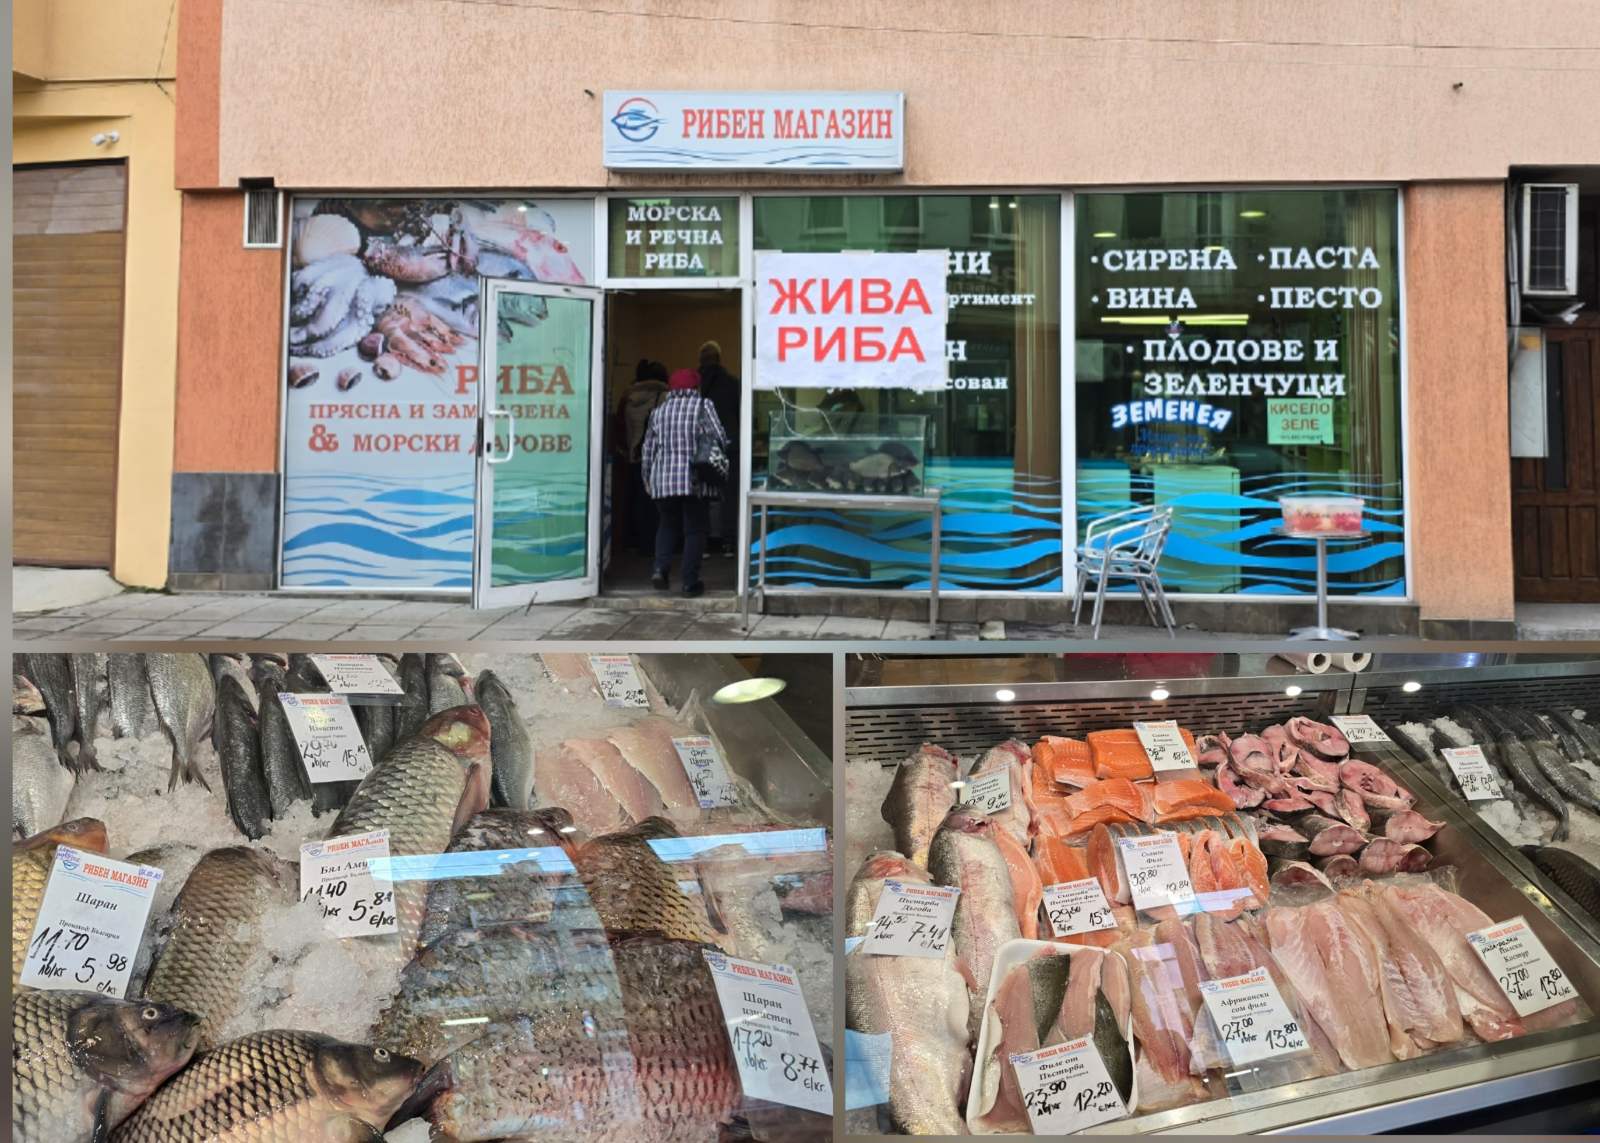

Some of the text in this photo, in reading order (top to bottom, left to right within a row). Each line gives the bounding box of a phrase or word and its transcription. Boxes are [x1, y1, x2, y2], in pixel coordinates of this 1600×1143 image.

[682, 109, 893, 139] РИБЕН МАГАЗИН
[627, 206, 722, 222] МОРСКА
[625, 230, 723, 245] И РЕЧНА
[645, 254, 704, 270] РИБА
[1102, 247, 1380, 271] СИРЕНА ПАСТА
[769, 278, 933, 315] ЖИВА
[949, 291, 1036, 306] ртимент
[1106, 287, 1383, 309] ВИНА ПЕСТО
[777, 326, 926, 363] РИБА
[1143, 339, 1338, 365] ПЛОДОВЕ И
[1144, 373, 1346, 399] ЗЕЛЕНЧУЦИ
[308, 404, 571, 419] ПРЯСНА И ЗАМАЗЕНА
[1111, 398, 1232, 431] ЗЕМЕНЕЯ
[1270, 402, 1330, 416] КИСЕЛО
[1281, 418, 1320, 430] ЗЕЛЕ
[308, 424, 340, 452] &
[353, 434, 461, 452] МОРСКИ
[83, 863, 109, 879] РИБЕН
[110, 870, 149, 889] МАГАЗИН
[321, 865, 341, 875] Бял
[75, 892, 118, 911] Шаран
[731, 963, 756, 978] РИБЕН
[757, 969, 793, 986] МАГАЗИН
[742, 991, 782, 1009] Шаран
[1220, 992, 1269, 1007] Африкански
[1231, 1006, 1246, 1014] сом
[1247, 1001, 1267, 1011] филе
[1036, 1050, 1057, 1060] РИБЕН
[1058, 1040, 1088, 1054] МАГАЗИН
[1039, 1061, 1062, 1071] Филе
